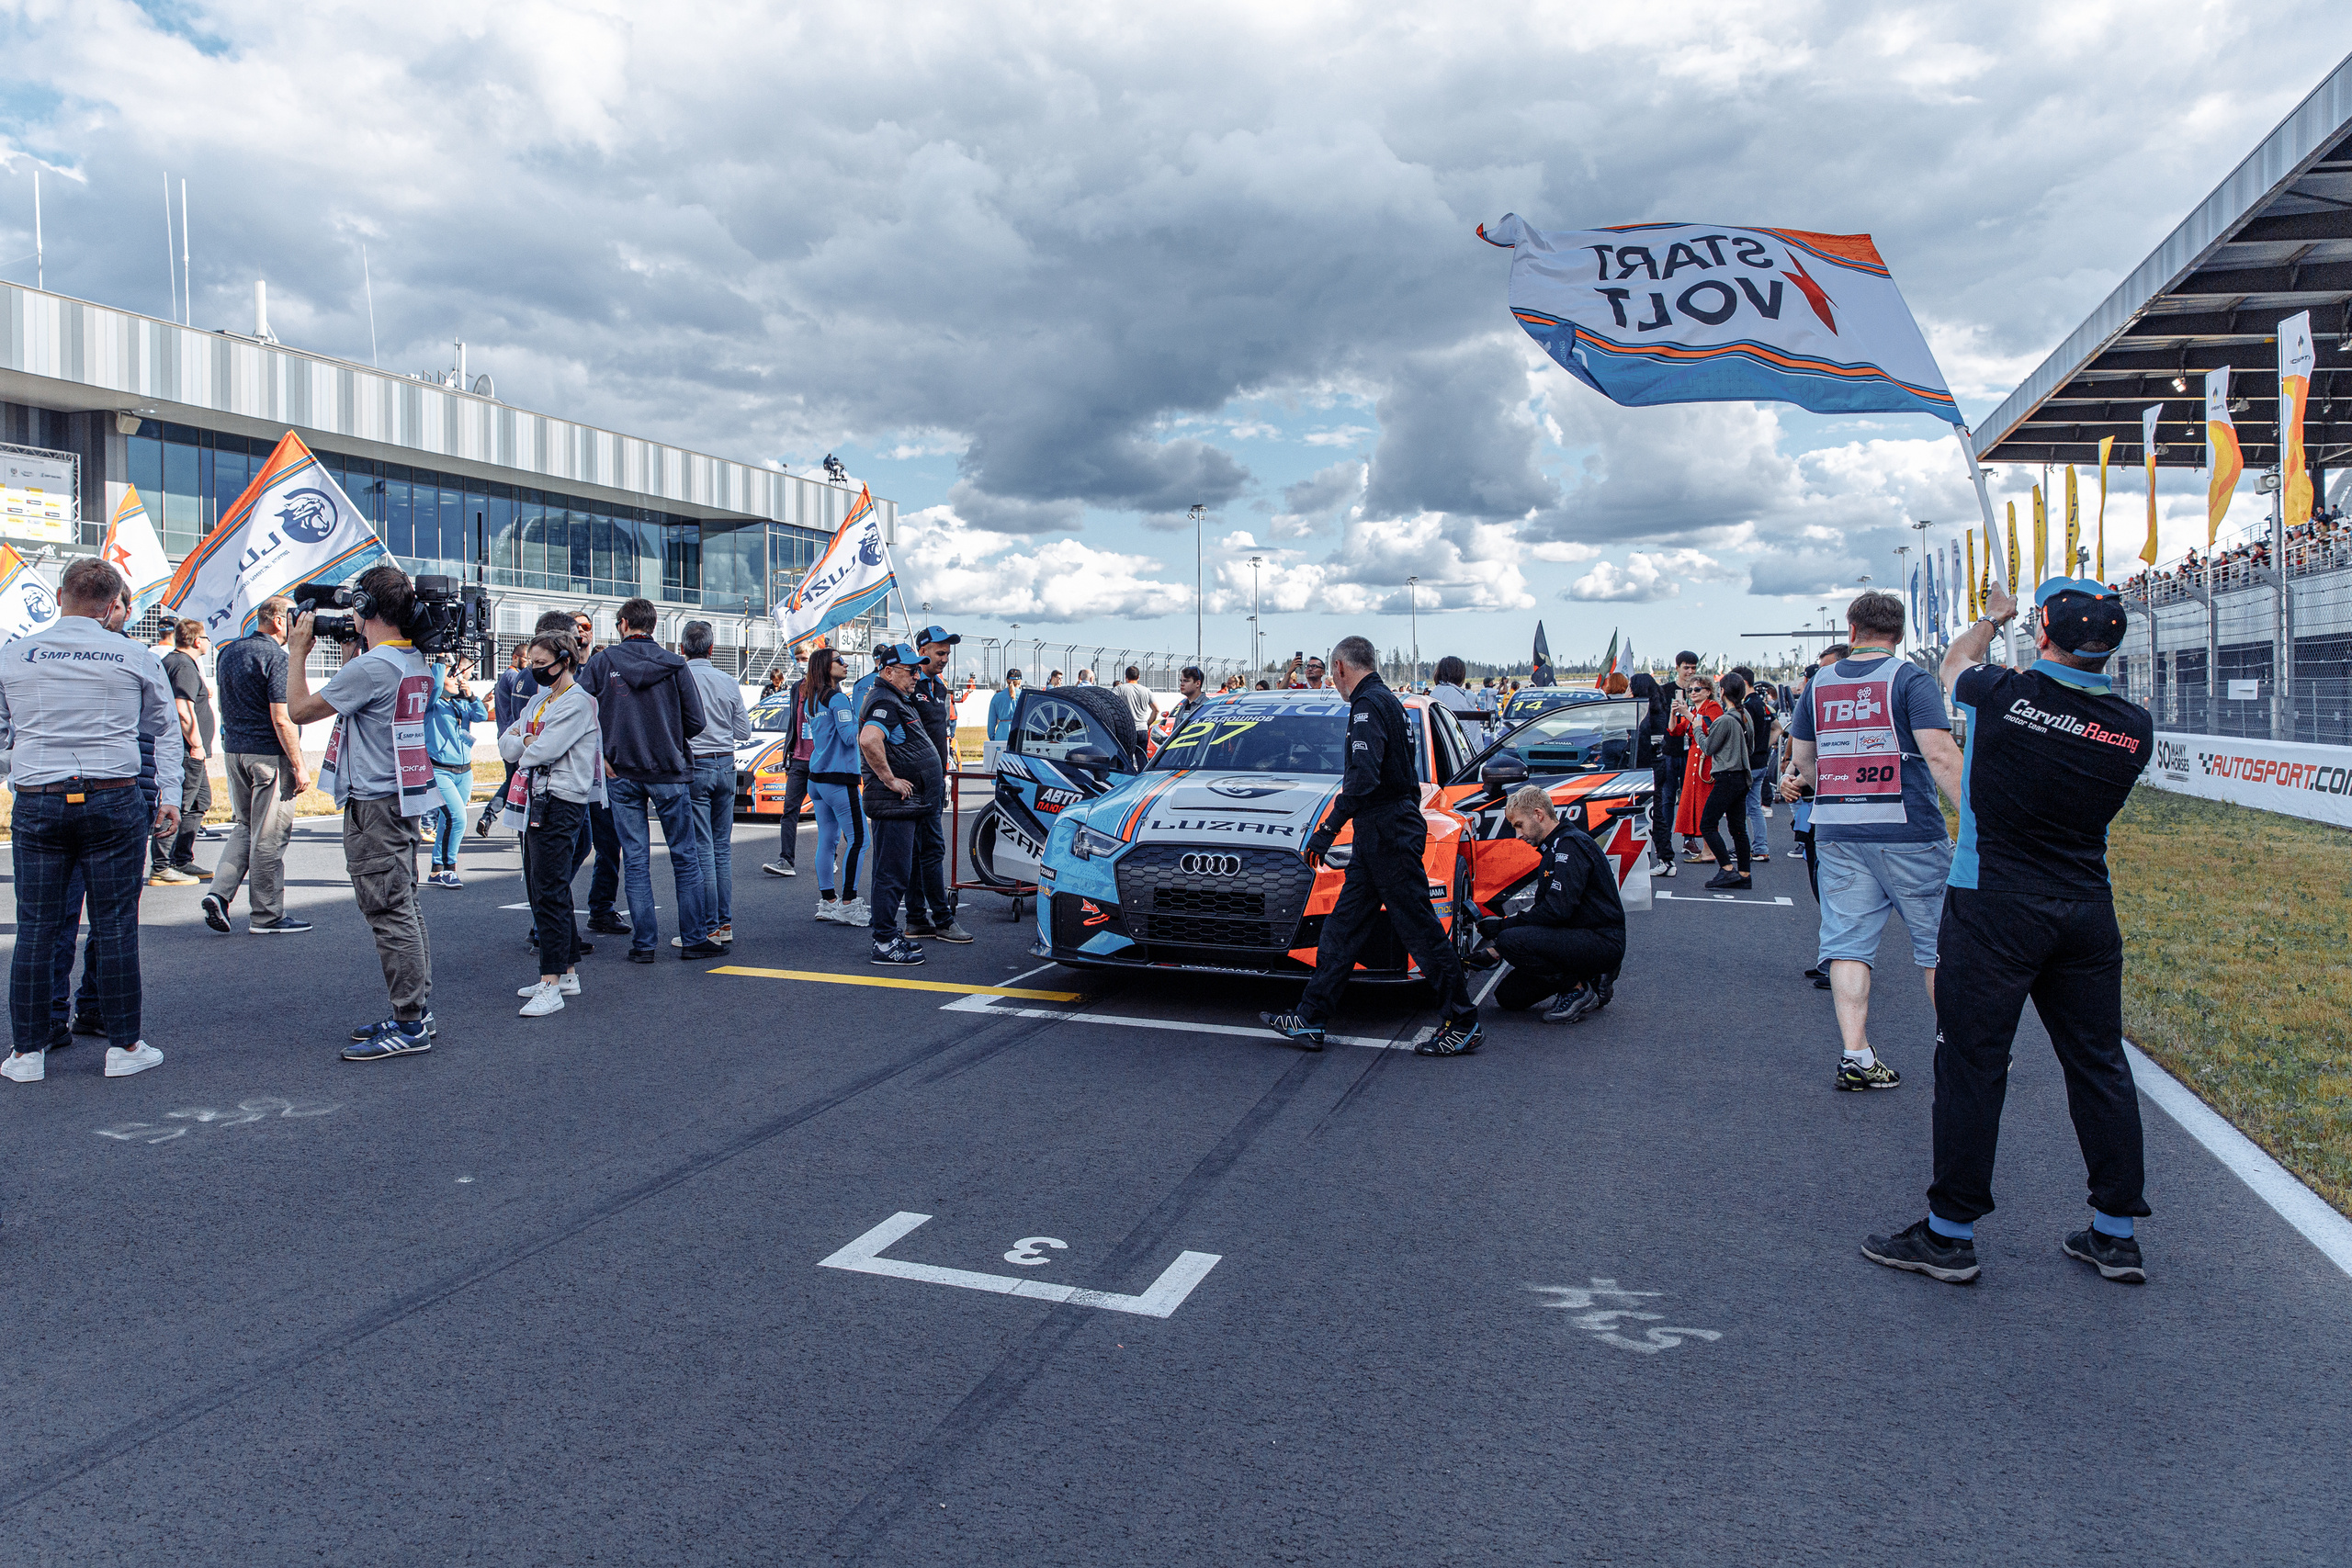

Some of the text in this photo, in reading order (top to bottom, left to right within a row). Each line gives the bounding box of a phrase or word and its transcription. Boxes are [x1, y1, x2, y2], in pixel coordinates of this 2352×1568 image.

[40, 651, 125, 662] SMP RACING
[1201, 703, 1351, 717] BETCI
[1512, 701, 1544, 712] 14
[1823, 700, 1856, 723] ТВ
[2004, 714, 2048, 734] motor team
[1165, 721, 1259, 750] 27
[2157, 739, 2170, 770] SO
[2171, 743, 2187, 758] MANY
[1856, 765, 1894, 784] 320
[2171, 758, 2189, 773] HORSES
[1151, 820, 1295, 837] LUZAR
[1003, 1236, 1069, 1266] 3
